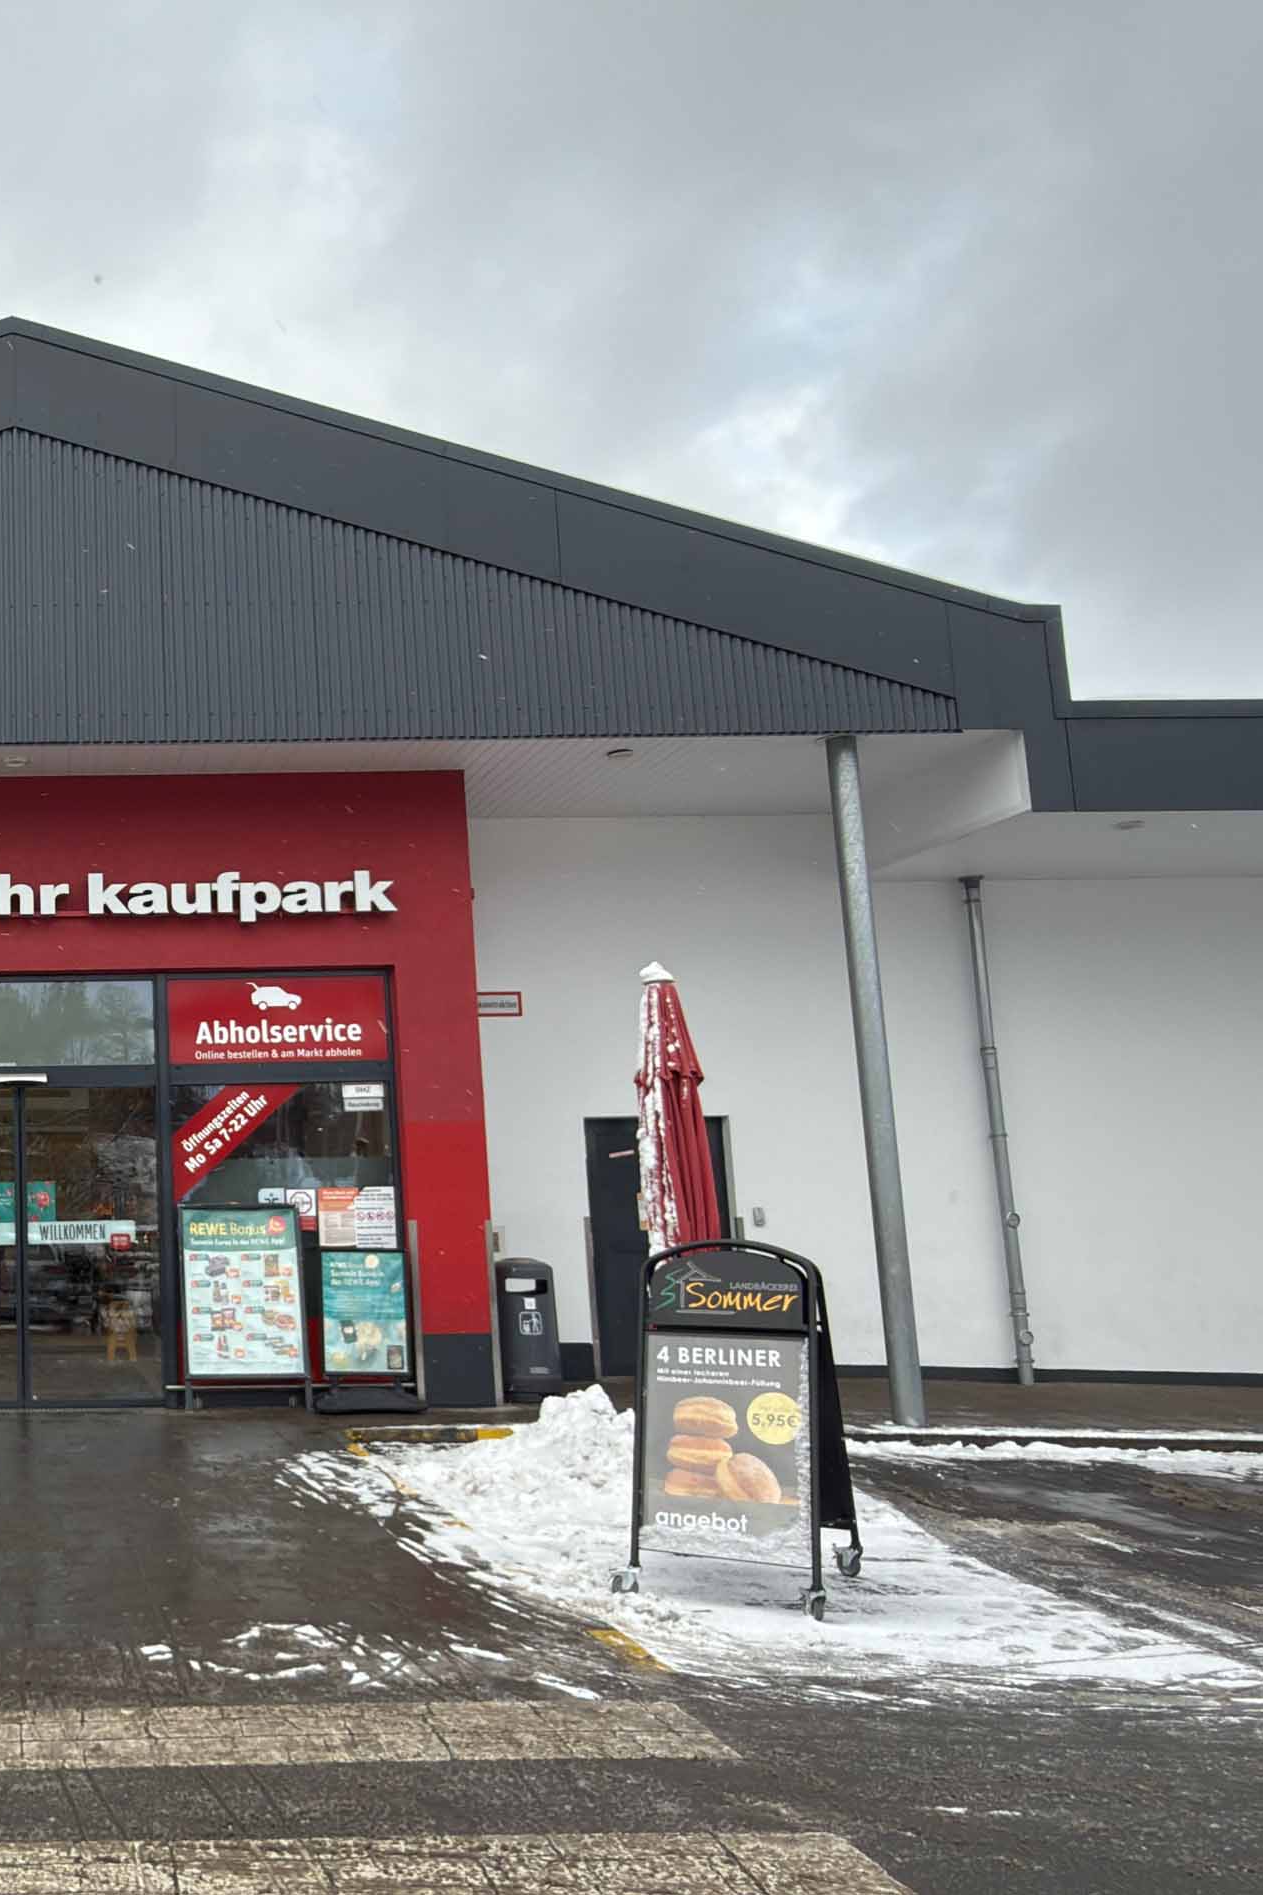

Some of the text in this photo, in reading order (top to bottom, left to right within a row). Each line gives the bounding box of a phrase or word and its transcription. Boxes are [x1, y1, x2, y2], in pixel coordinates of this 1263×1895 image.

[87, 870, 398, 922] kaufpark
[195, 1017, 362, 1045] Abholservice
[194, 1047, 362, 1060] Online bestellen & am Markt abholen
[180, 1091, 250, 1152] Öffnungszeiten
[184, 1153, 207, 1174] Mo
[203, 1138, 223, 1156] Sa
[242, 1094, 268, 1117] Uhr
[39, 1224, 106, 1241] WILLKOMMEN
[189, 1222, 226, 1236] REWE
[685, 1282, 799, 1312] Sommer
[656, 1345, 781, 1368] 4 BERLINER
[655, 1511, 748, 1532] angebot
